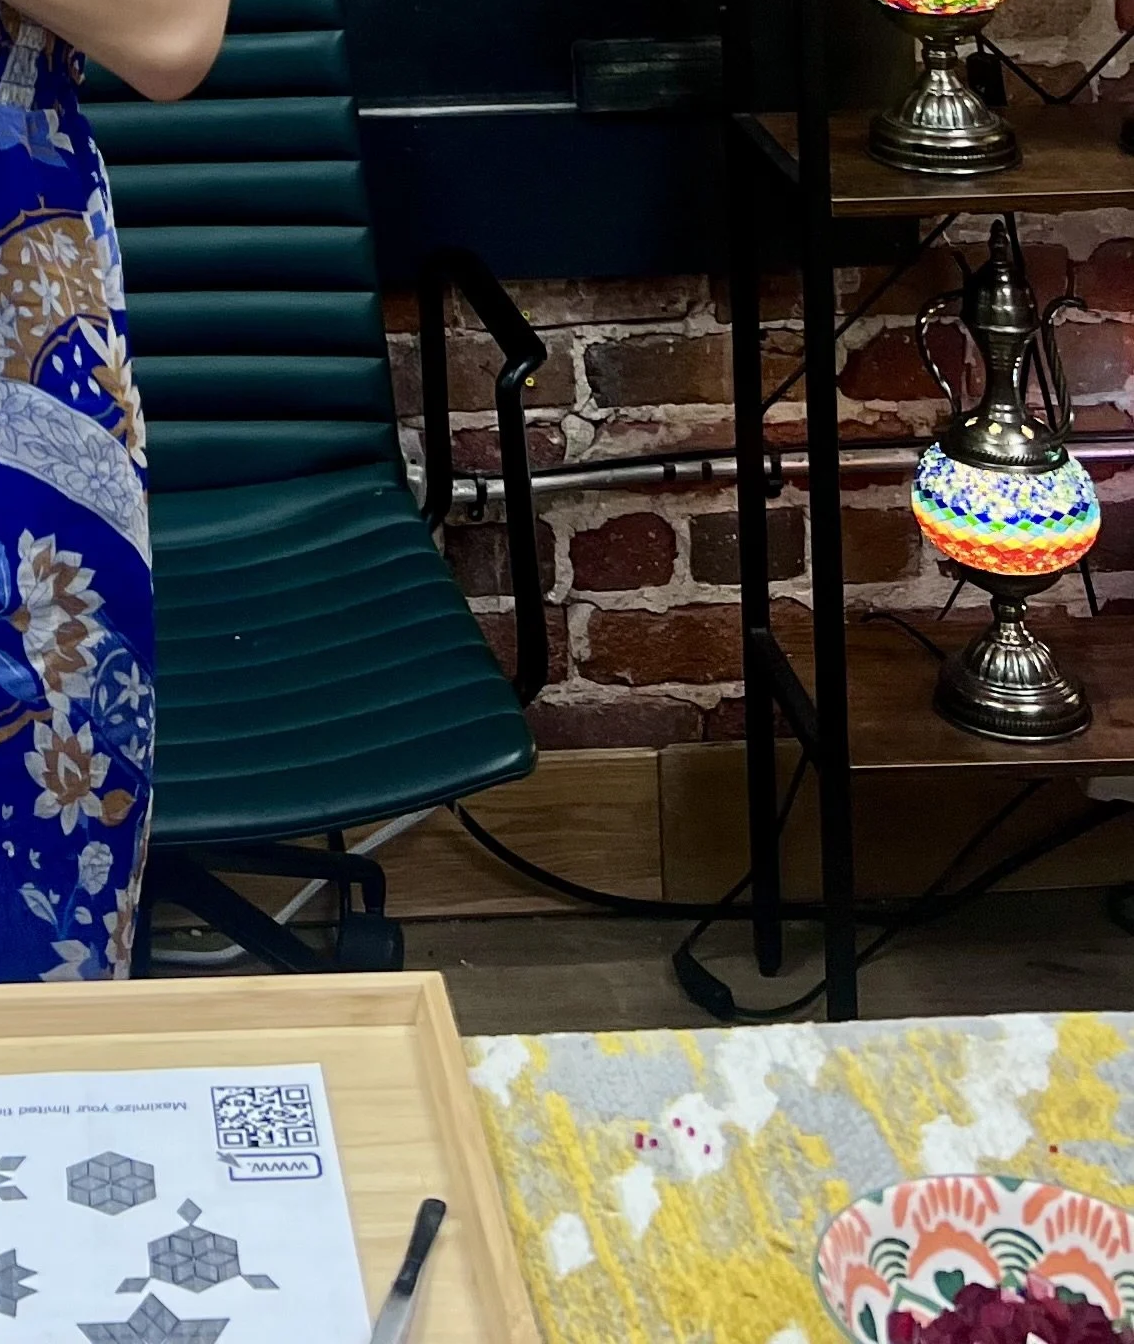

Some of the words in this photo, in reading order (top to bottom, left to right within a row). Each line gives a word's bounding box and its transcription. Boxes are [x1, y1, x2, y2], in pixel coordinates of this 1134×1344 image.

[19, 1104, 70, 1116] limited
[76, 1102, 110, 1114] your
[115, 1101, 188, 1112] Maximize
